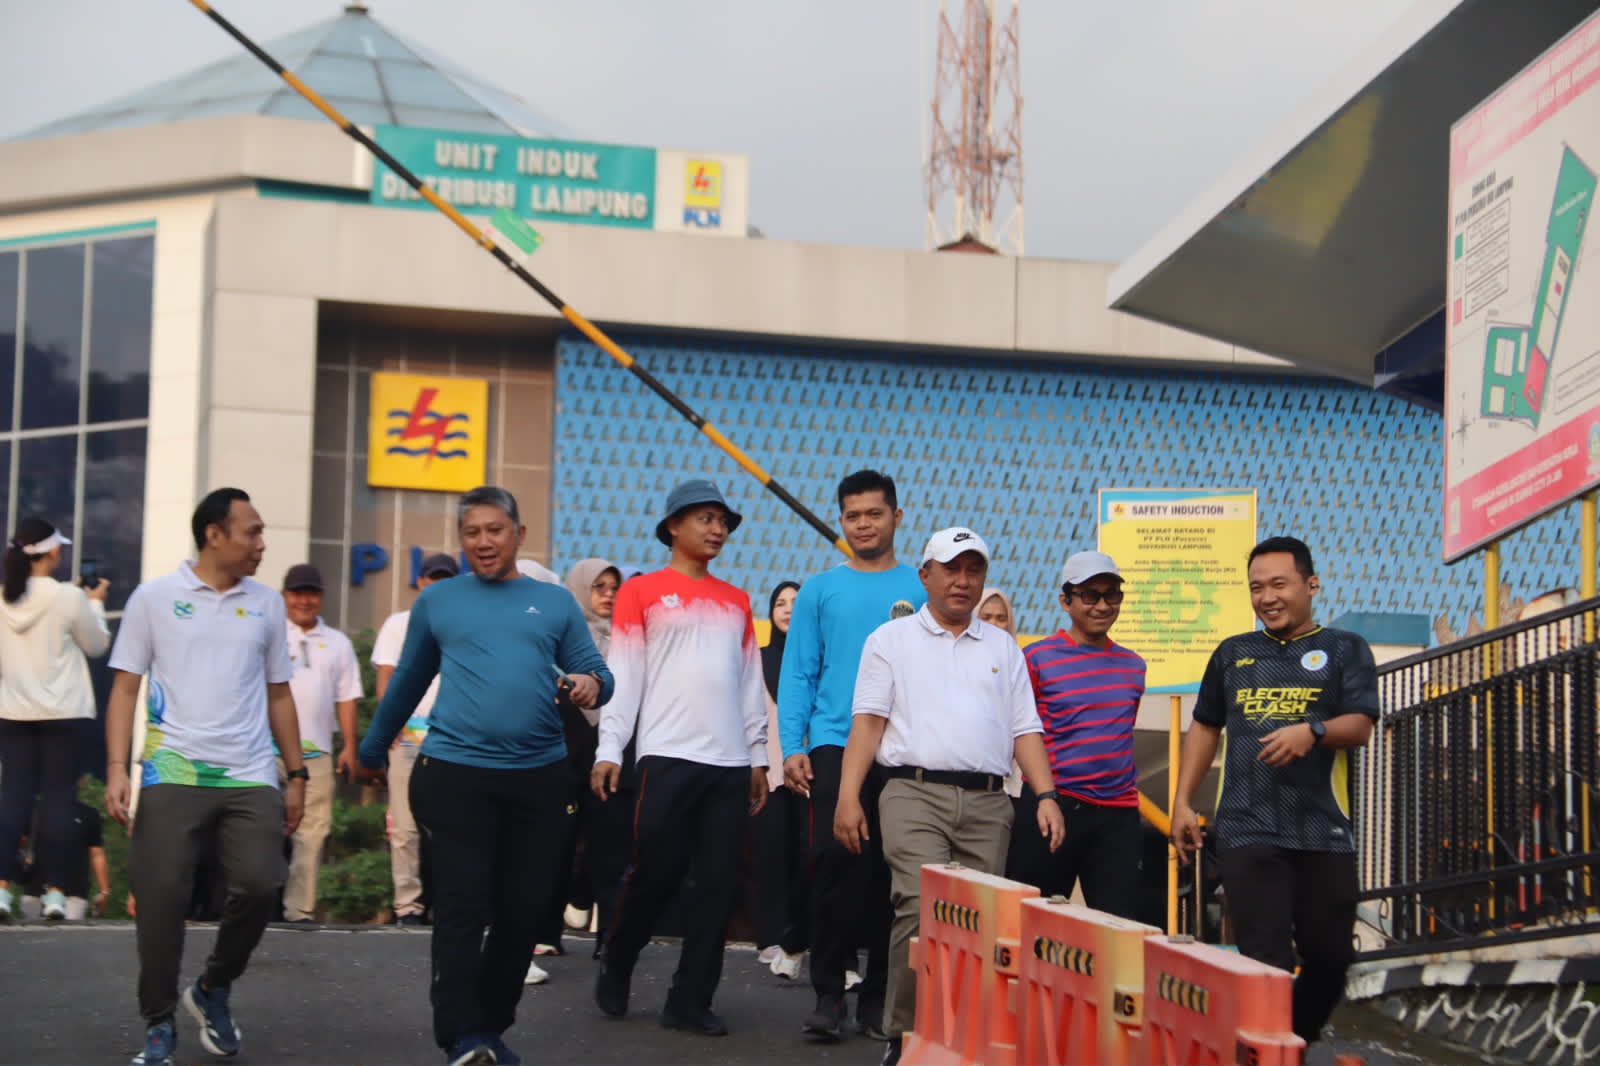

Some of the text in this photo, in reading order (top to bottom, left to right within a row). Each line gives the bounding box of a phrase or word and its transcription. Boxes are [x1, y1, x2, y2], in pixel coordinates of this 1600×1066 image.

[435, 140, 599, 180] UNIT INDUK
[532, 184, 648, 219] LAMPUNG
[682, 207, 721, 227] PLN
[1132, 505, 1224, 515] SAFETY INDUCTION
[350, 543, 474, 588] PL
[1236, 688, 1323, 703] ELECTRIC
[1243, 701, 1308, 715] CLASH
